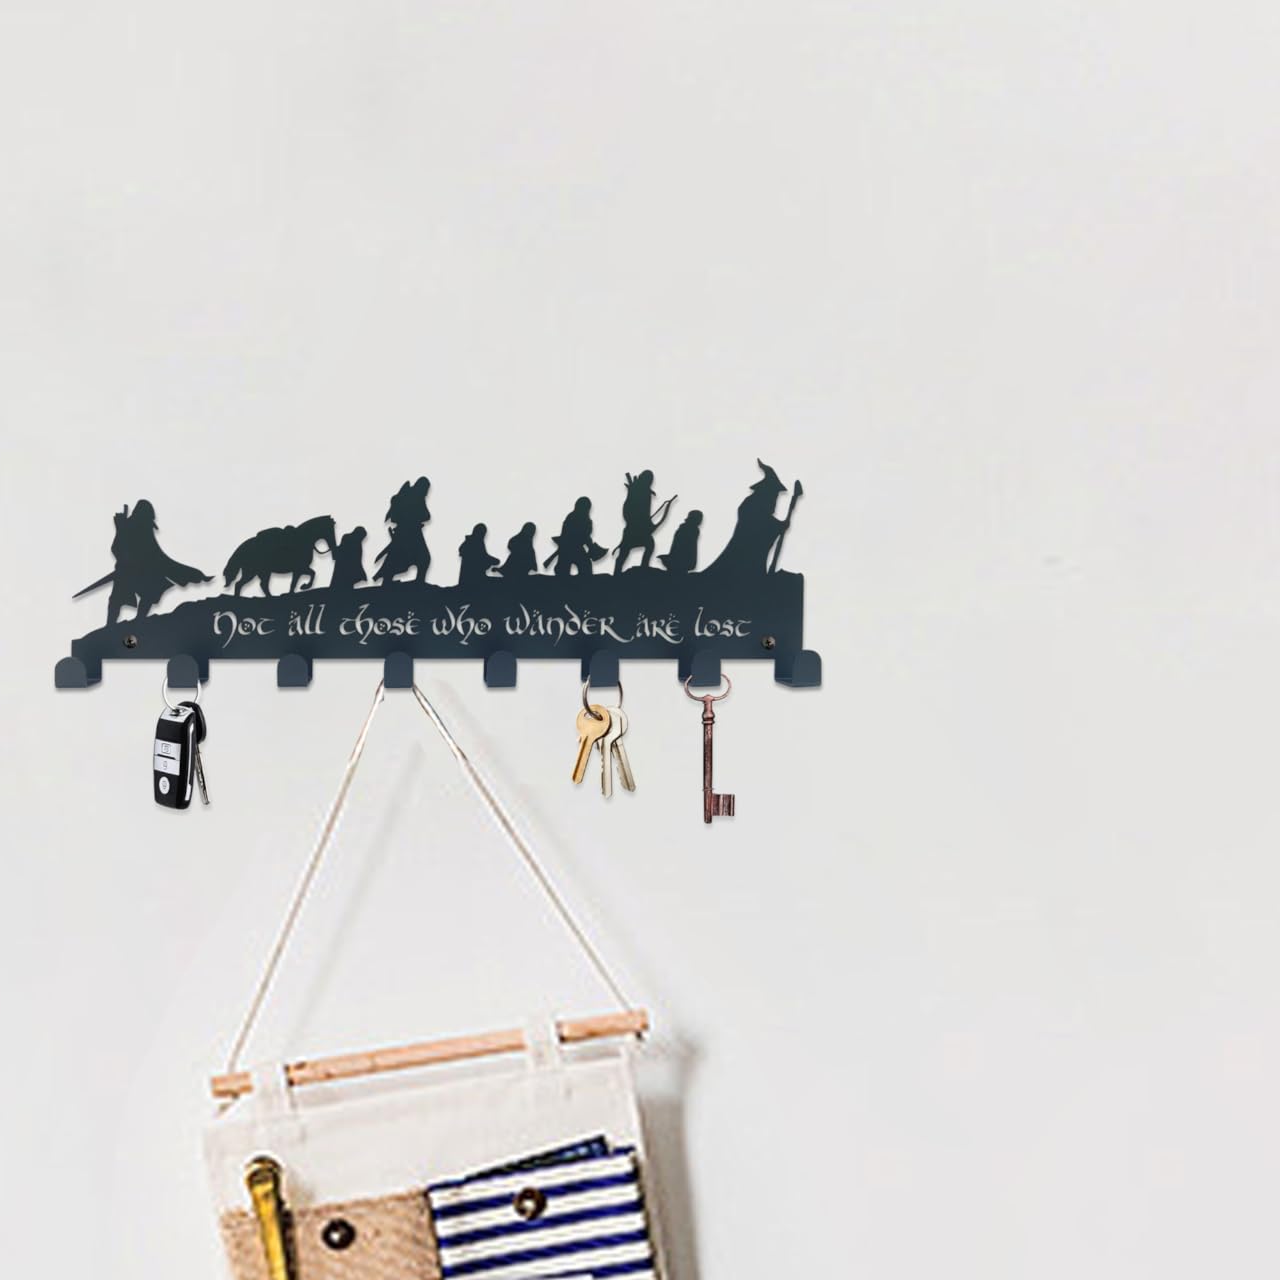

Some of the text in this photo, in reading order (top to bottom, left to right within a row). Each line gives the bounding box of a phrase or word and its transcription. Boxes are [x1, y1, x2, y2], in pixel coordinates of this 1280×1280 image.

[288, 604, 326, 637] all
[339, 603, 420, 645] those
[431, 604, 492, 646] who
[504, 603, 634, 646] wander
[635, 613, 684, 644] are
[694, 606, 752, 638] lost
